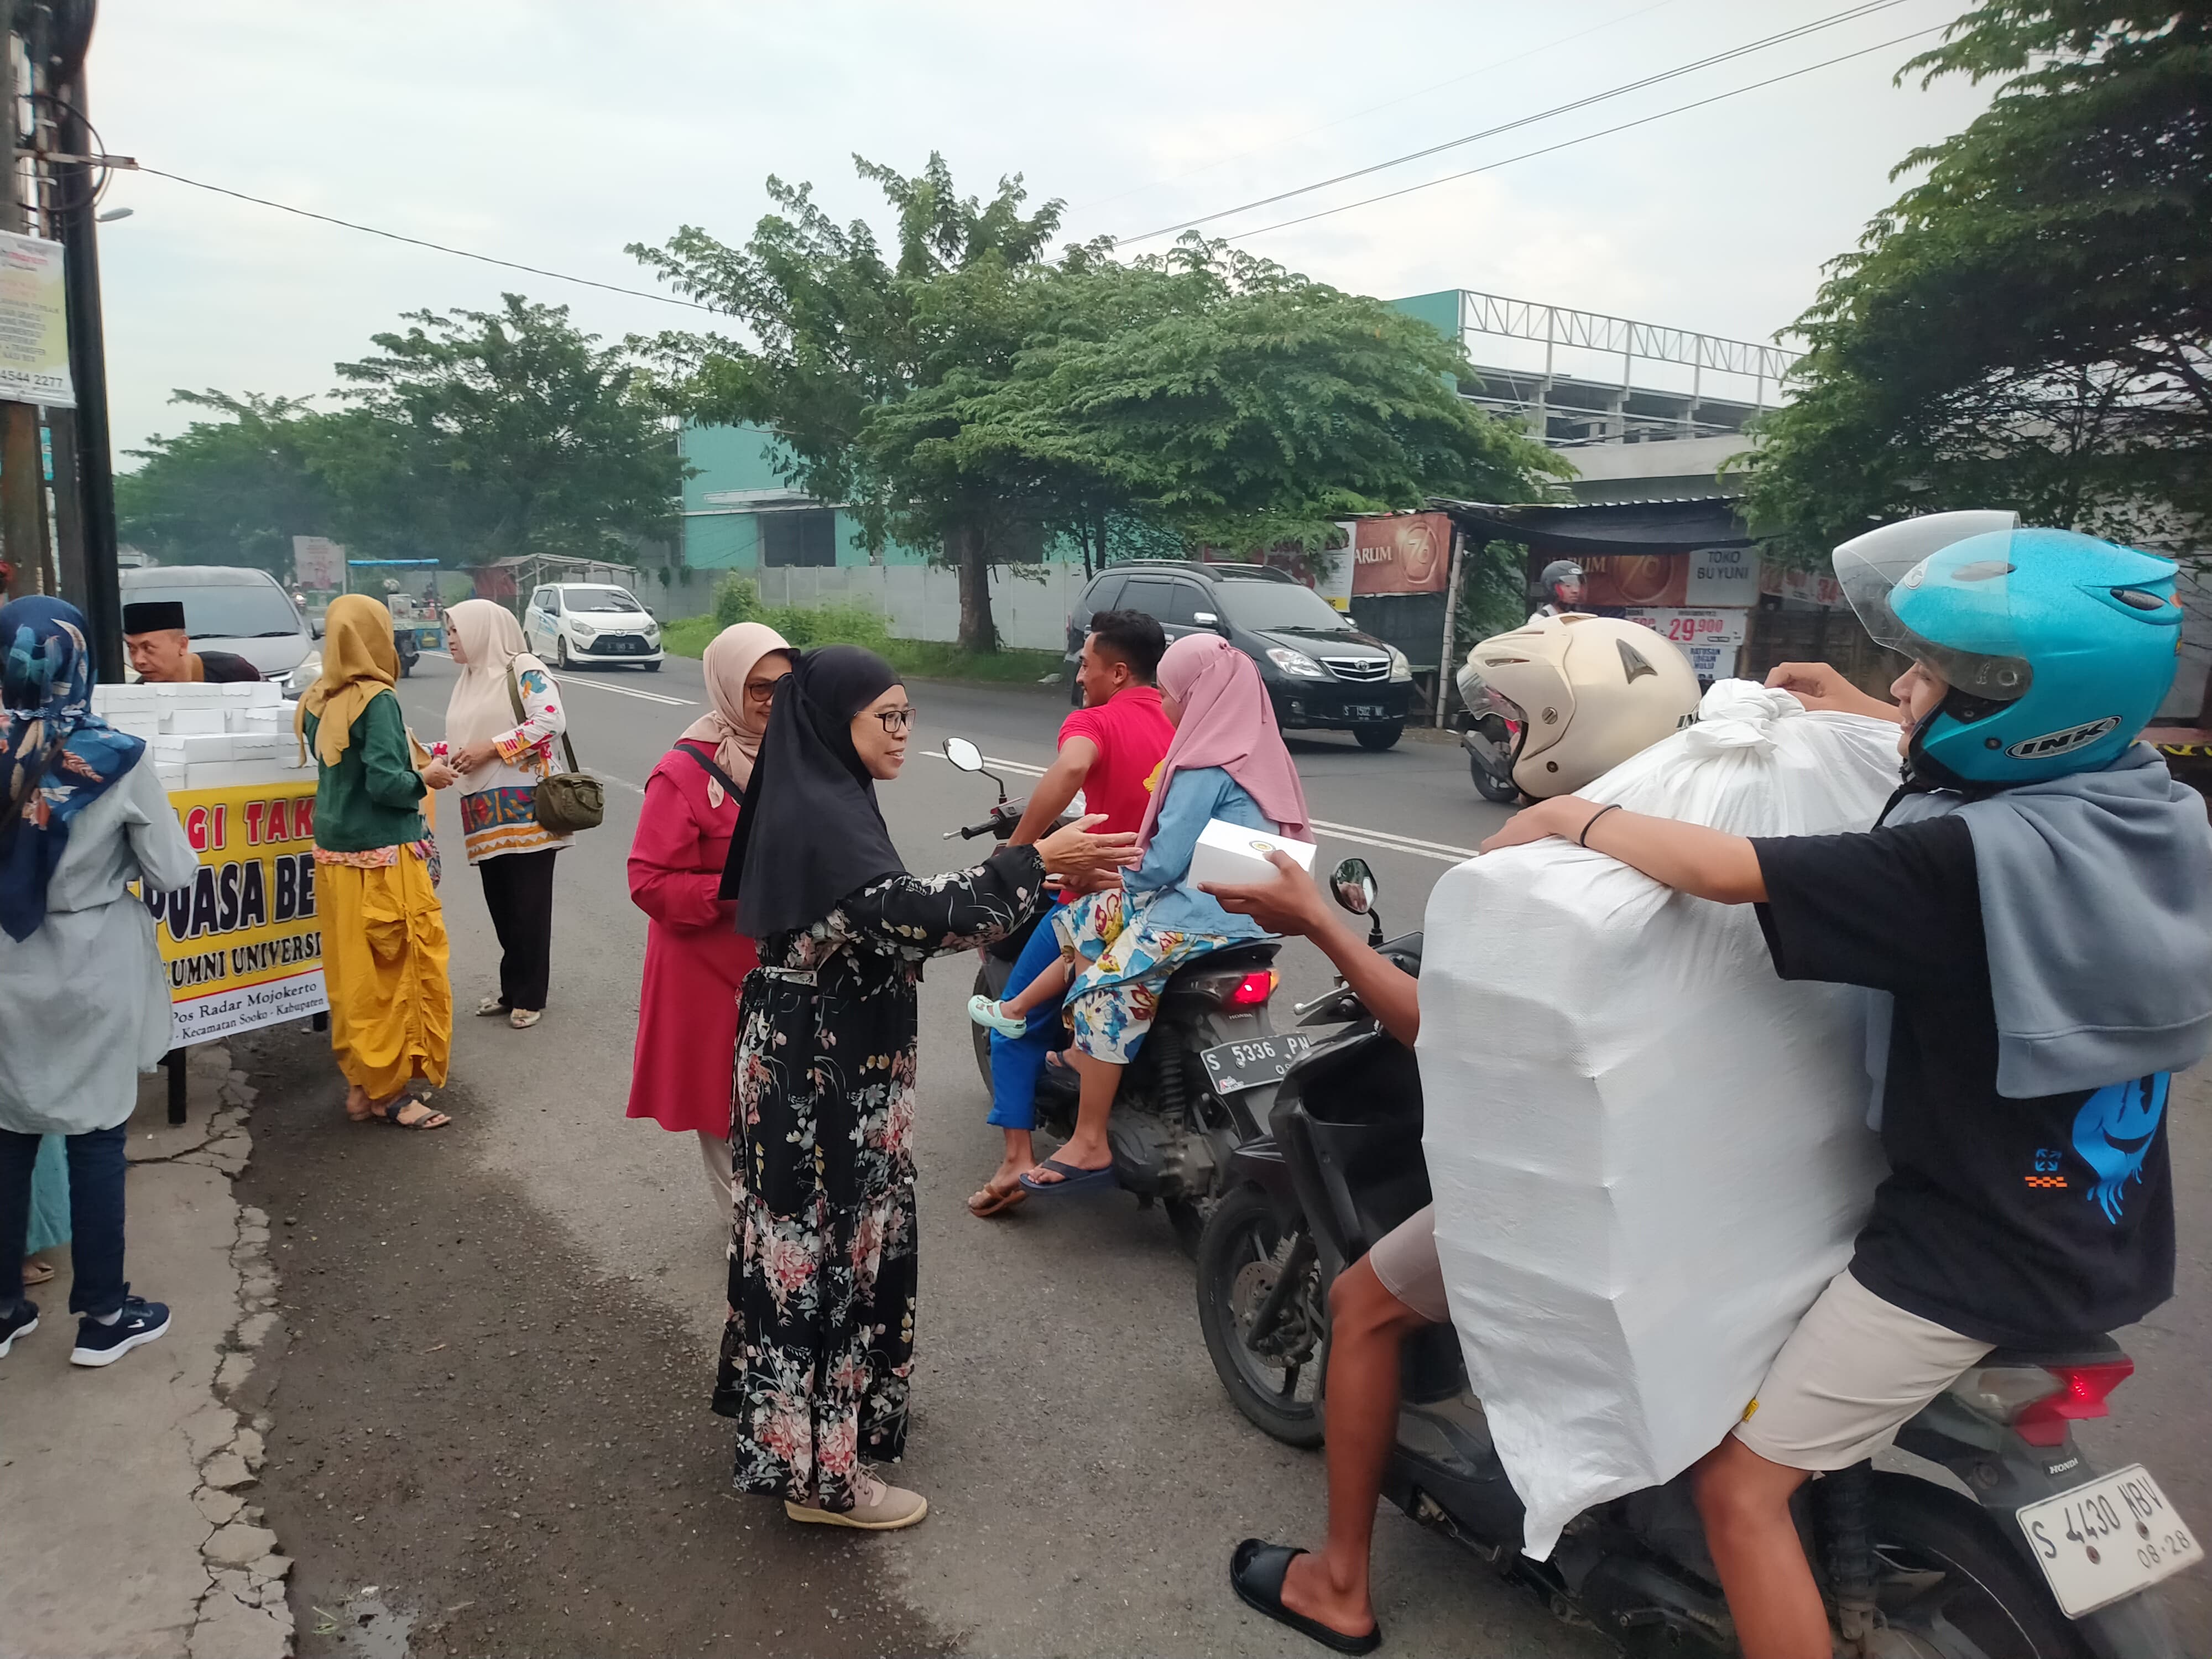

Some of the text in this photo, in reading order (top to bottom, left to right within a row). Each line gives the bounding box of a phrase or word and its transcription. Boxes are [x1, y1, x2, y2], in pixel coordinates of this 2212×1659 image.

[34, 374, 63, 388] 2277
[1355, 546, 1392, 565] ARUM
[1708, 551, 1740, 563] TOKO
[1717, 567, 1749, 579] YUNI
[1344, 705, 1349, 716] S
[2020, 719, 2108, 755] INK
[187, 804, 227, 852] GI
[163, 931, 322, 988] UMNI UNIVERSI
[199, 1000, 243, 1018] Radar
[247, 983, 317, 1007] Mojokerto
[182, 1020, 237, 1040] Kecamatan
[239, 1010, 268, 1025] Sooko
[276, 997, 324, 1016] Kabupaten
[1207, 1053, 1220, 1071] S
[1231, 1041, 1276, 1062] 5336
[2049, 1457, 2078, 1474] HONDA
[2032, 1521, 2057, 1558] S
[2065, 1494, 2121, 1543] 4430
